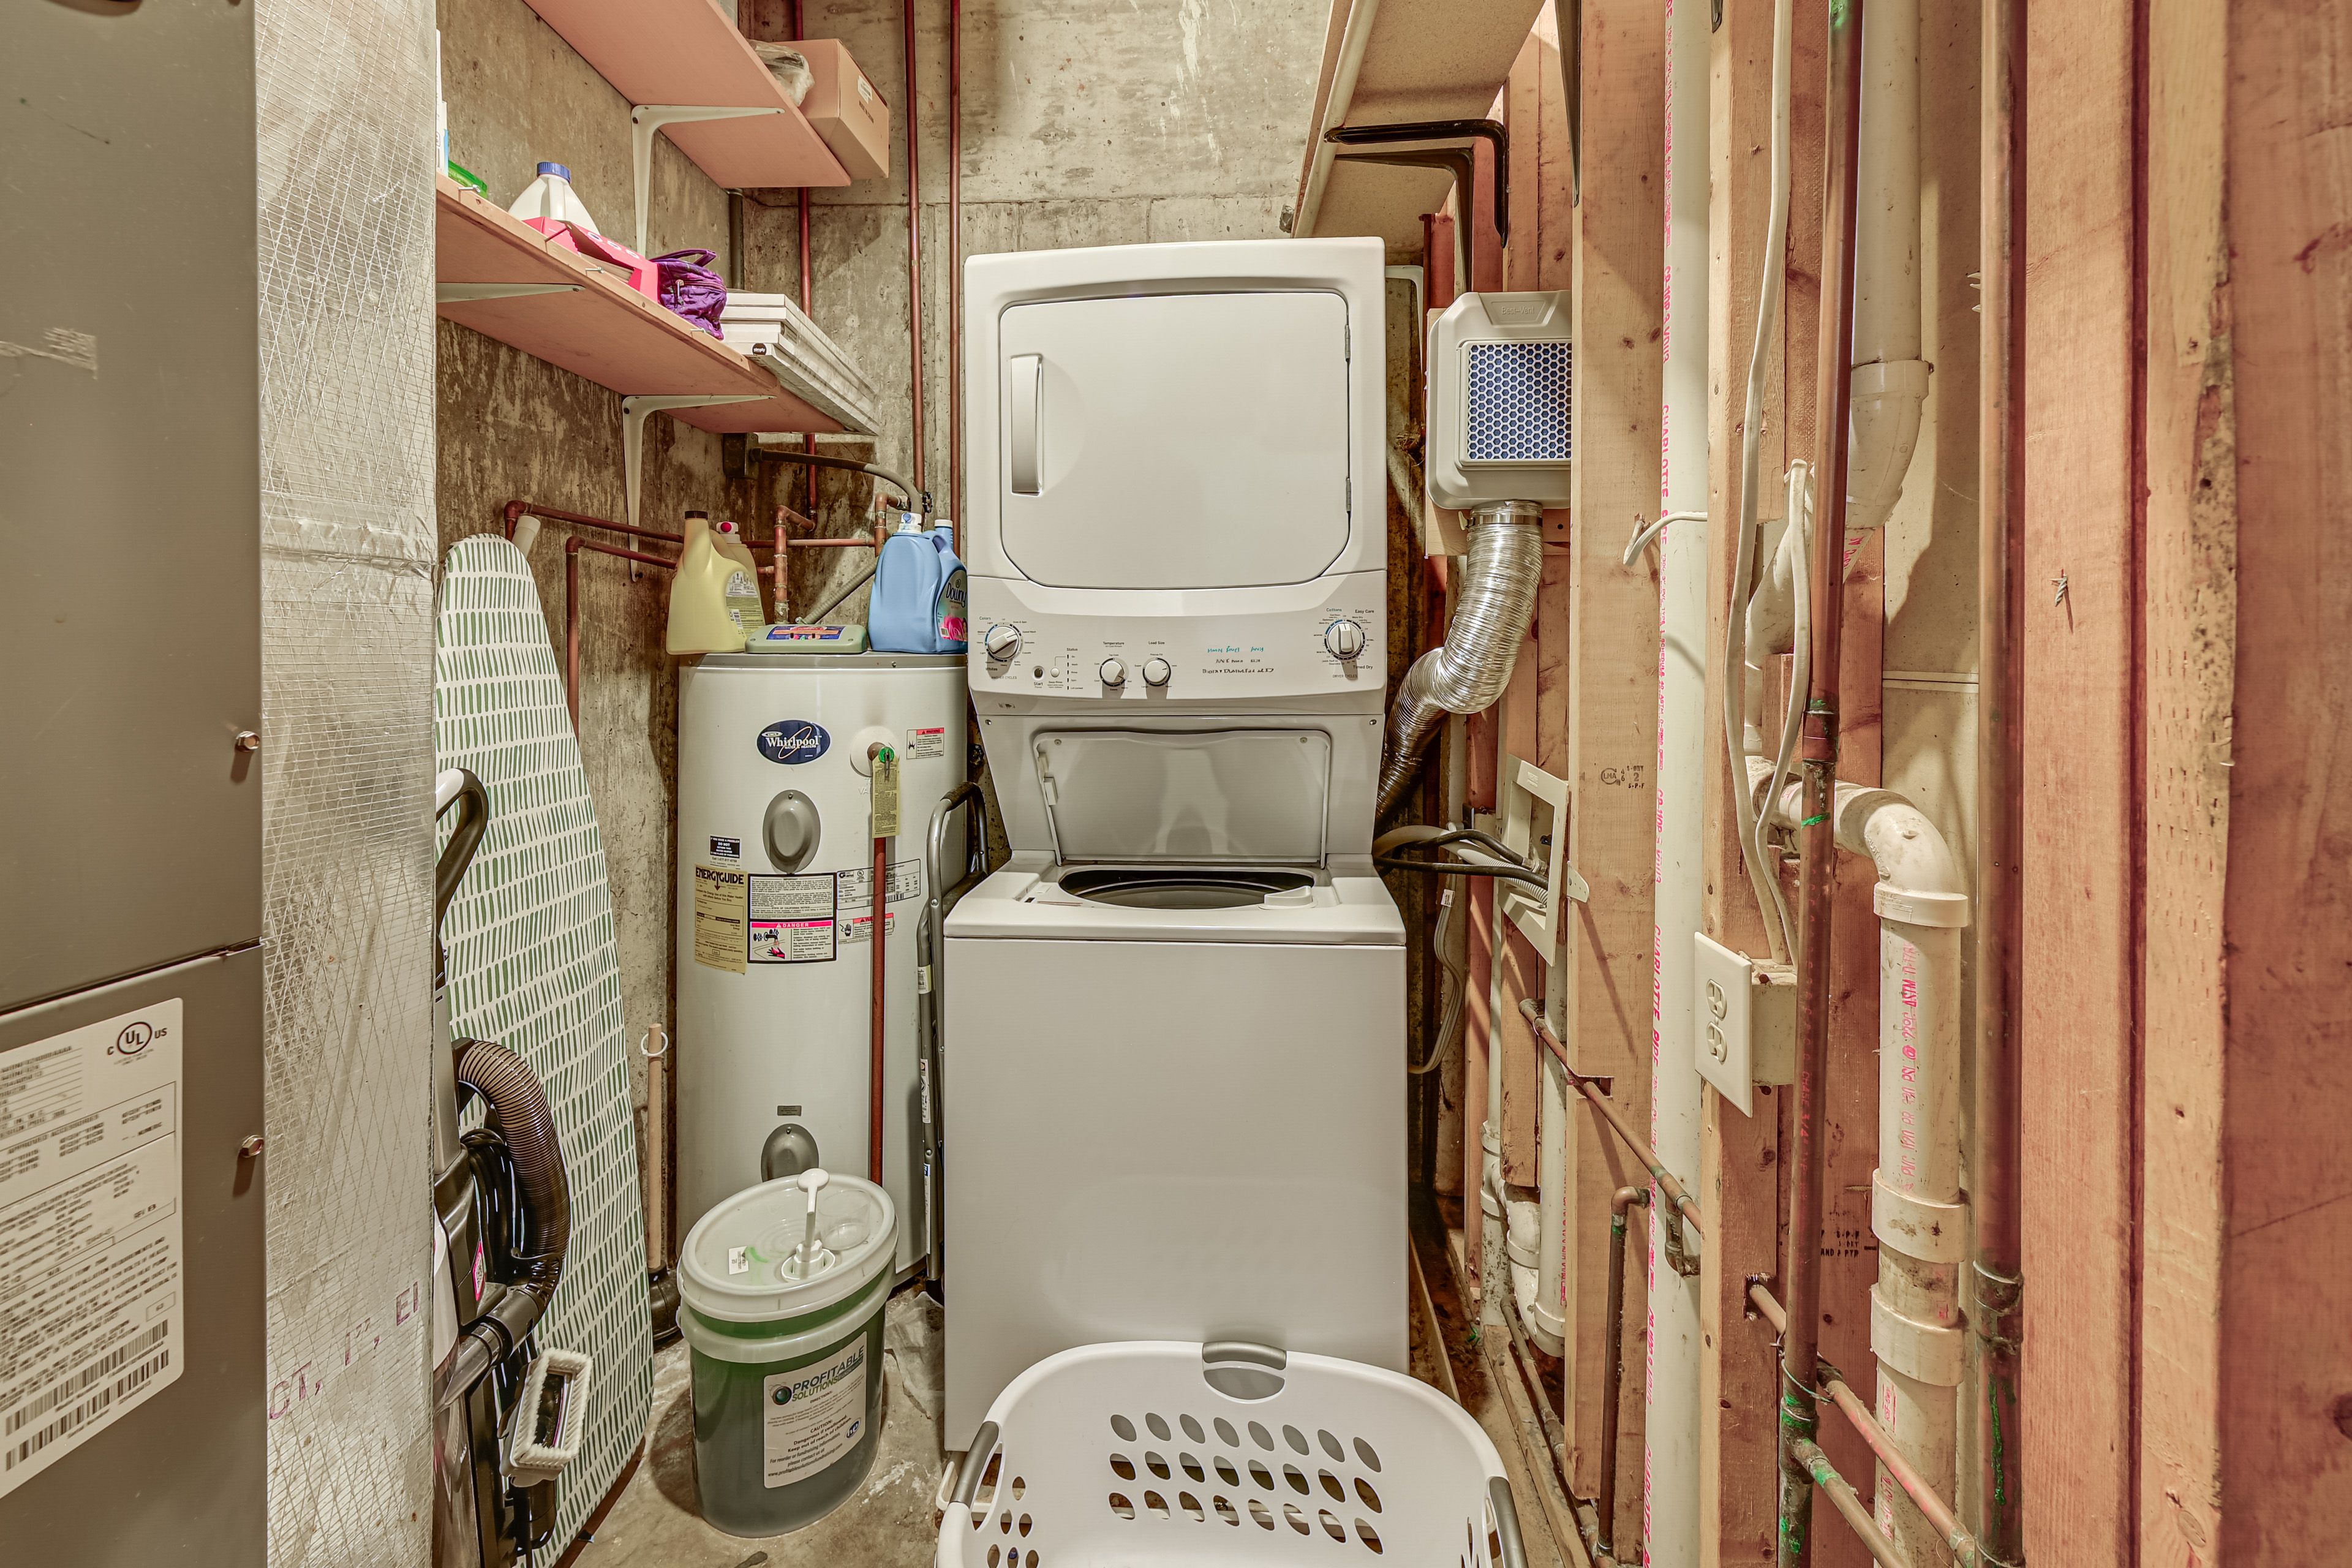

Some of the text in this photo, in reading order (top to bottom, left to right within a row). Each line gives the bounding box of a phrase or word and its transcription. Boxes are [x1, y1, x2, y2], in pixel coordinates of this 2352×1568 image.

[946, 582, 967, 608] Downy
[1660, 680, 1665, 690] 40
[766, 735, 820, 748] Whirlpool
[1634, 772, 1640, 782] 2
[696, 867, 744, 885] ENERGYGUIDE
[1902, 979, 1917, 1007] ASTM
[107, 1028, 168, 1055] C UL US
[1902, 1045, 1917, 1060] @
[1901, 1066, 1916, 1082] PSI
[1801, 1071, 1811, 1107] CHASE
[793, 1345, 864, 1393] PROFITABLE
[792, 1376, 839, 1401] SOLUTIONS
[810, 1419, 832, 1433] CAUTION:
[788, 1445, 800, 1453] Keep
[816, 1434, 828, 1443] reach
[793, 1432, 820, 1445] Dangerous
[797, 1445, 818, 1457] fundraising
[788, 1459, 800, 1468] please
[801, 1453, 815, 1463] contact
